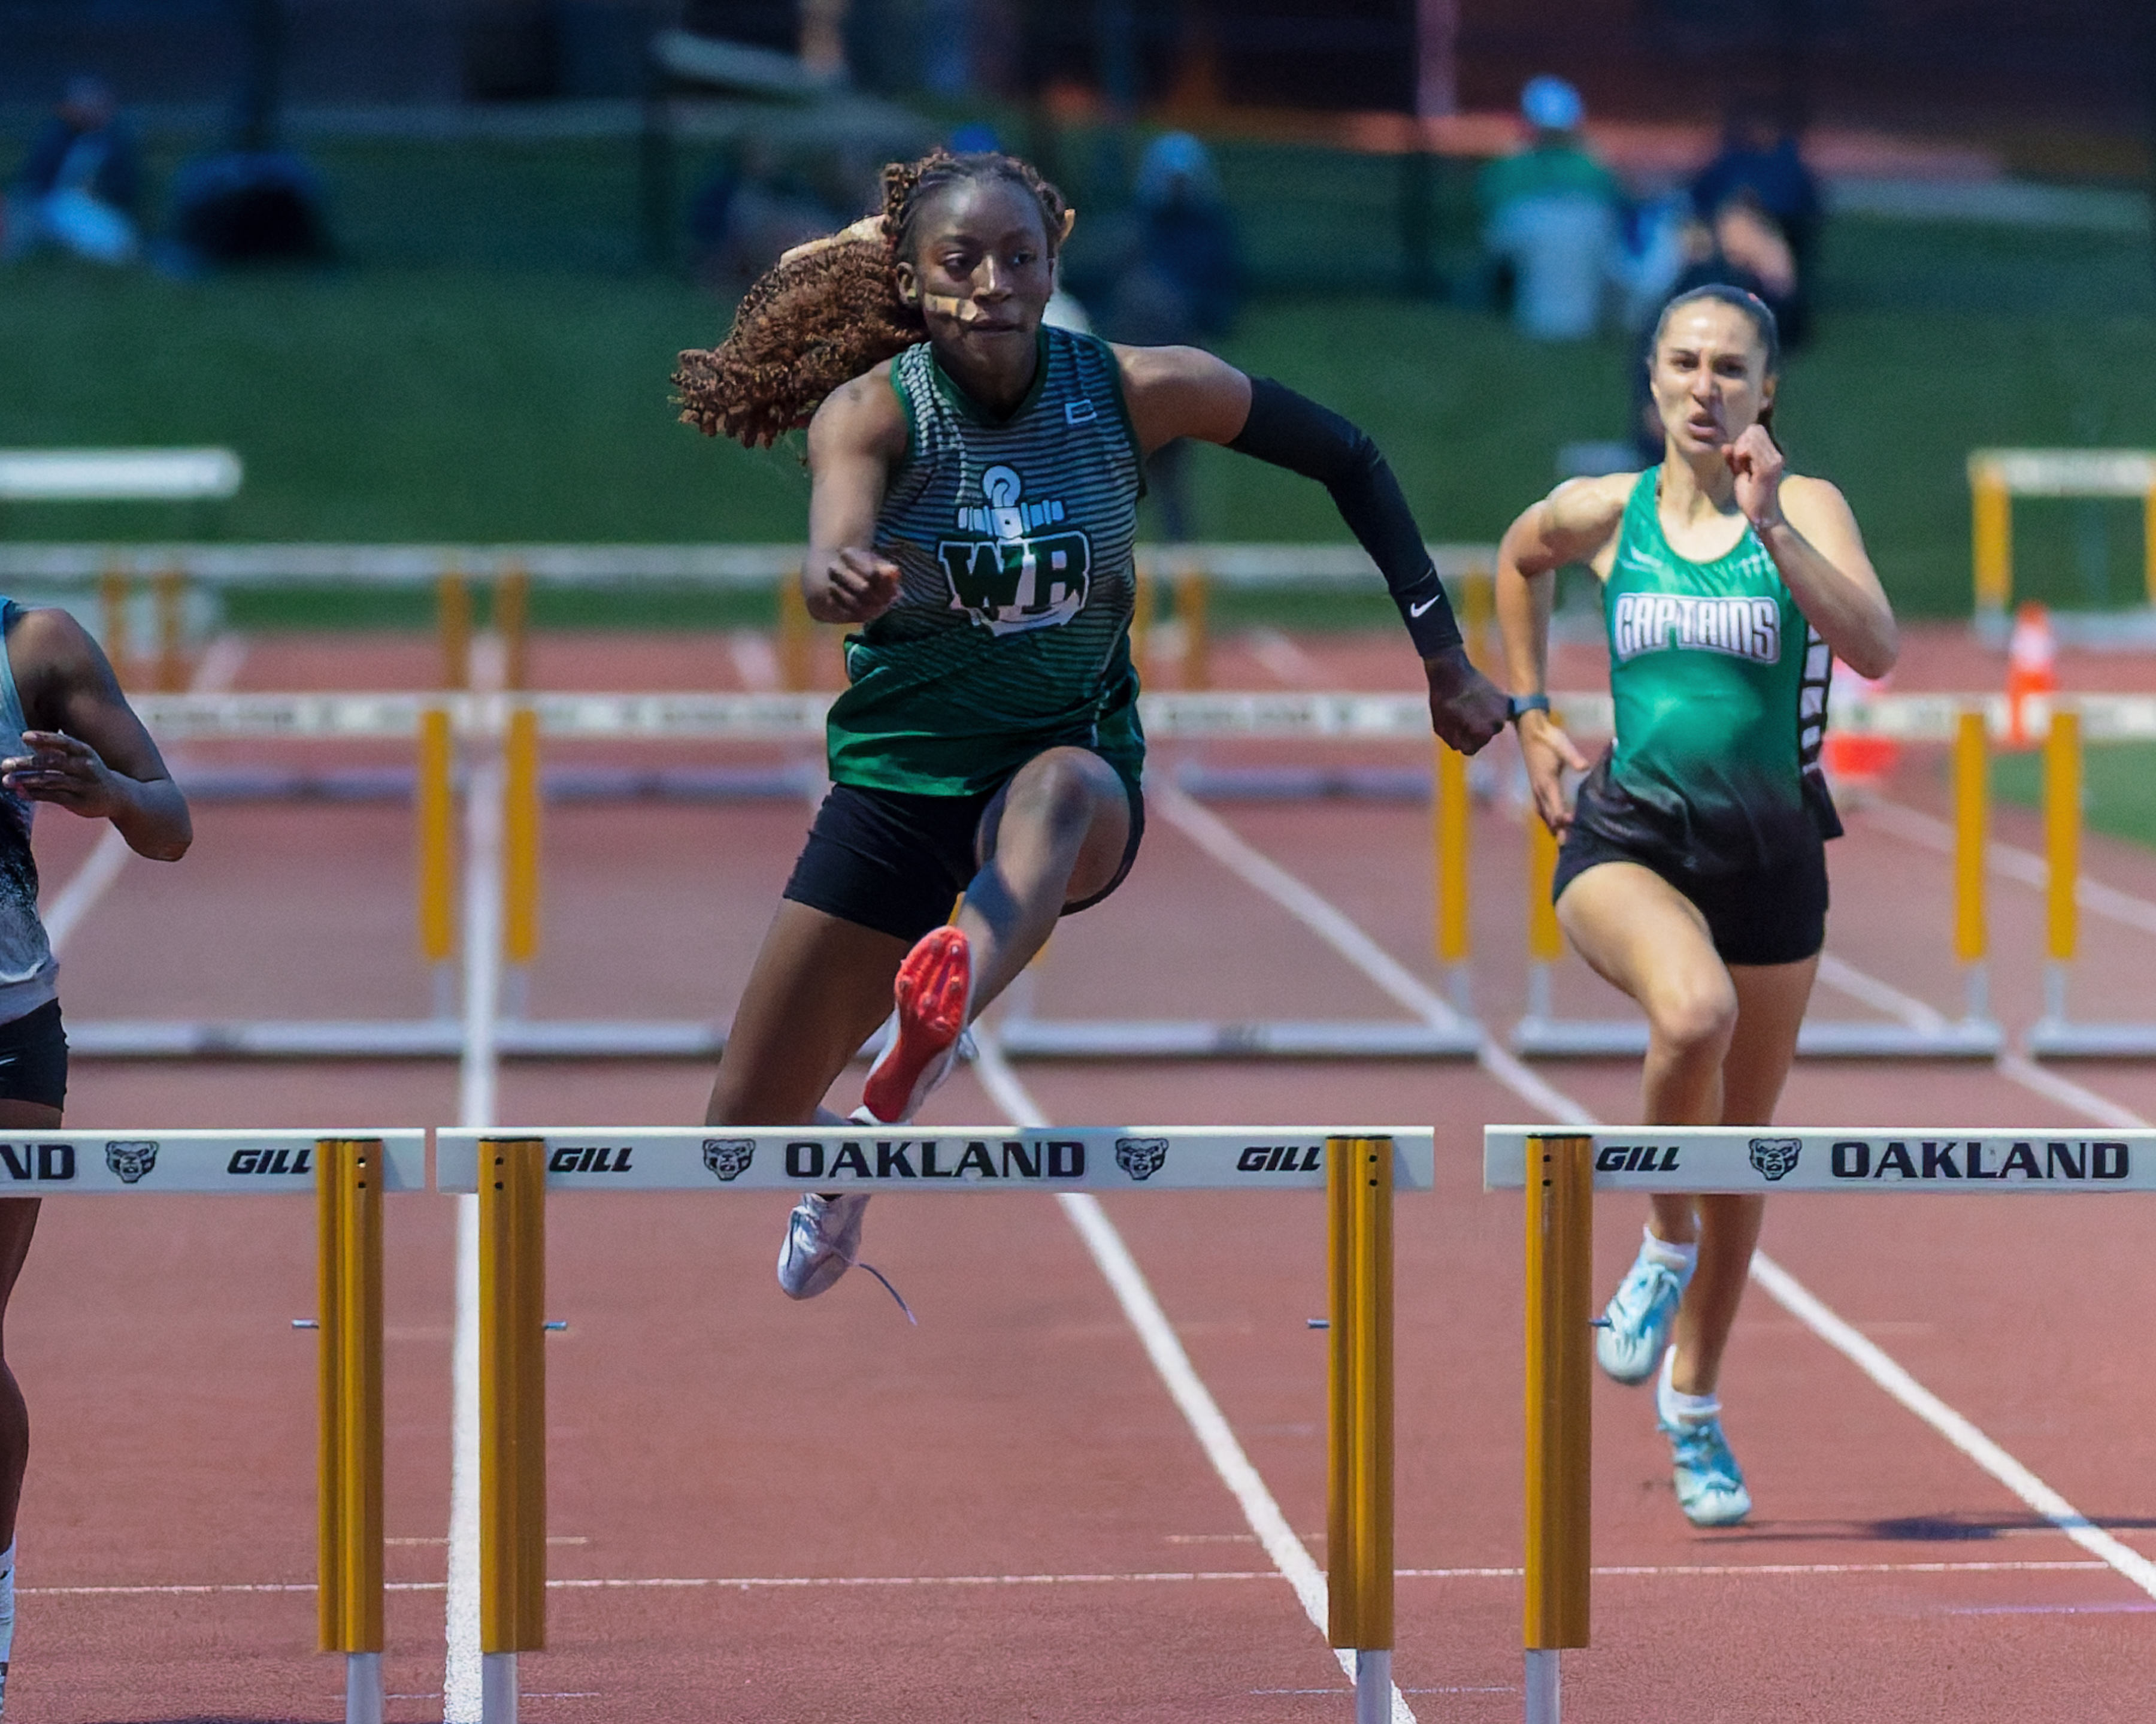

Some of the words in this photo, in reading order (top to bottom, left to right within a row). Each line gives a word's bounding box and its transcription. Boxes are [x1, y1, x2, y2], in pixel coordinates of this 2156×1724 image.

[226, 1148, 312, 1175] GILL
[548, 1147, 633, 1172] GILL
[785, 1141, 1085, 1178] OAKLAND
[1236, 1146, 1321, 1171] GILL
[1594, 1145, 1680, 1172] GILL
[1831, 1141, 2130, 1179] OAKLAND
